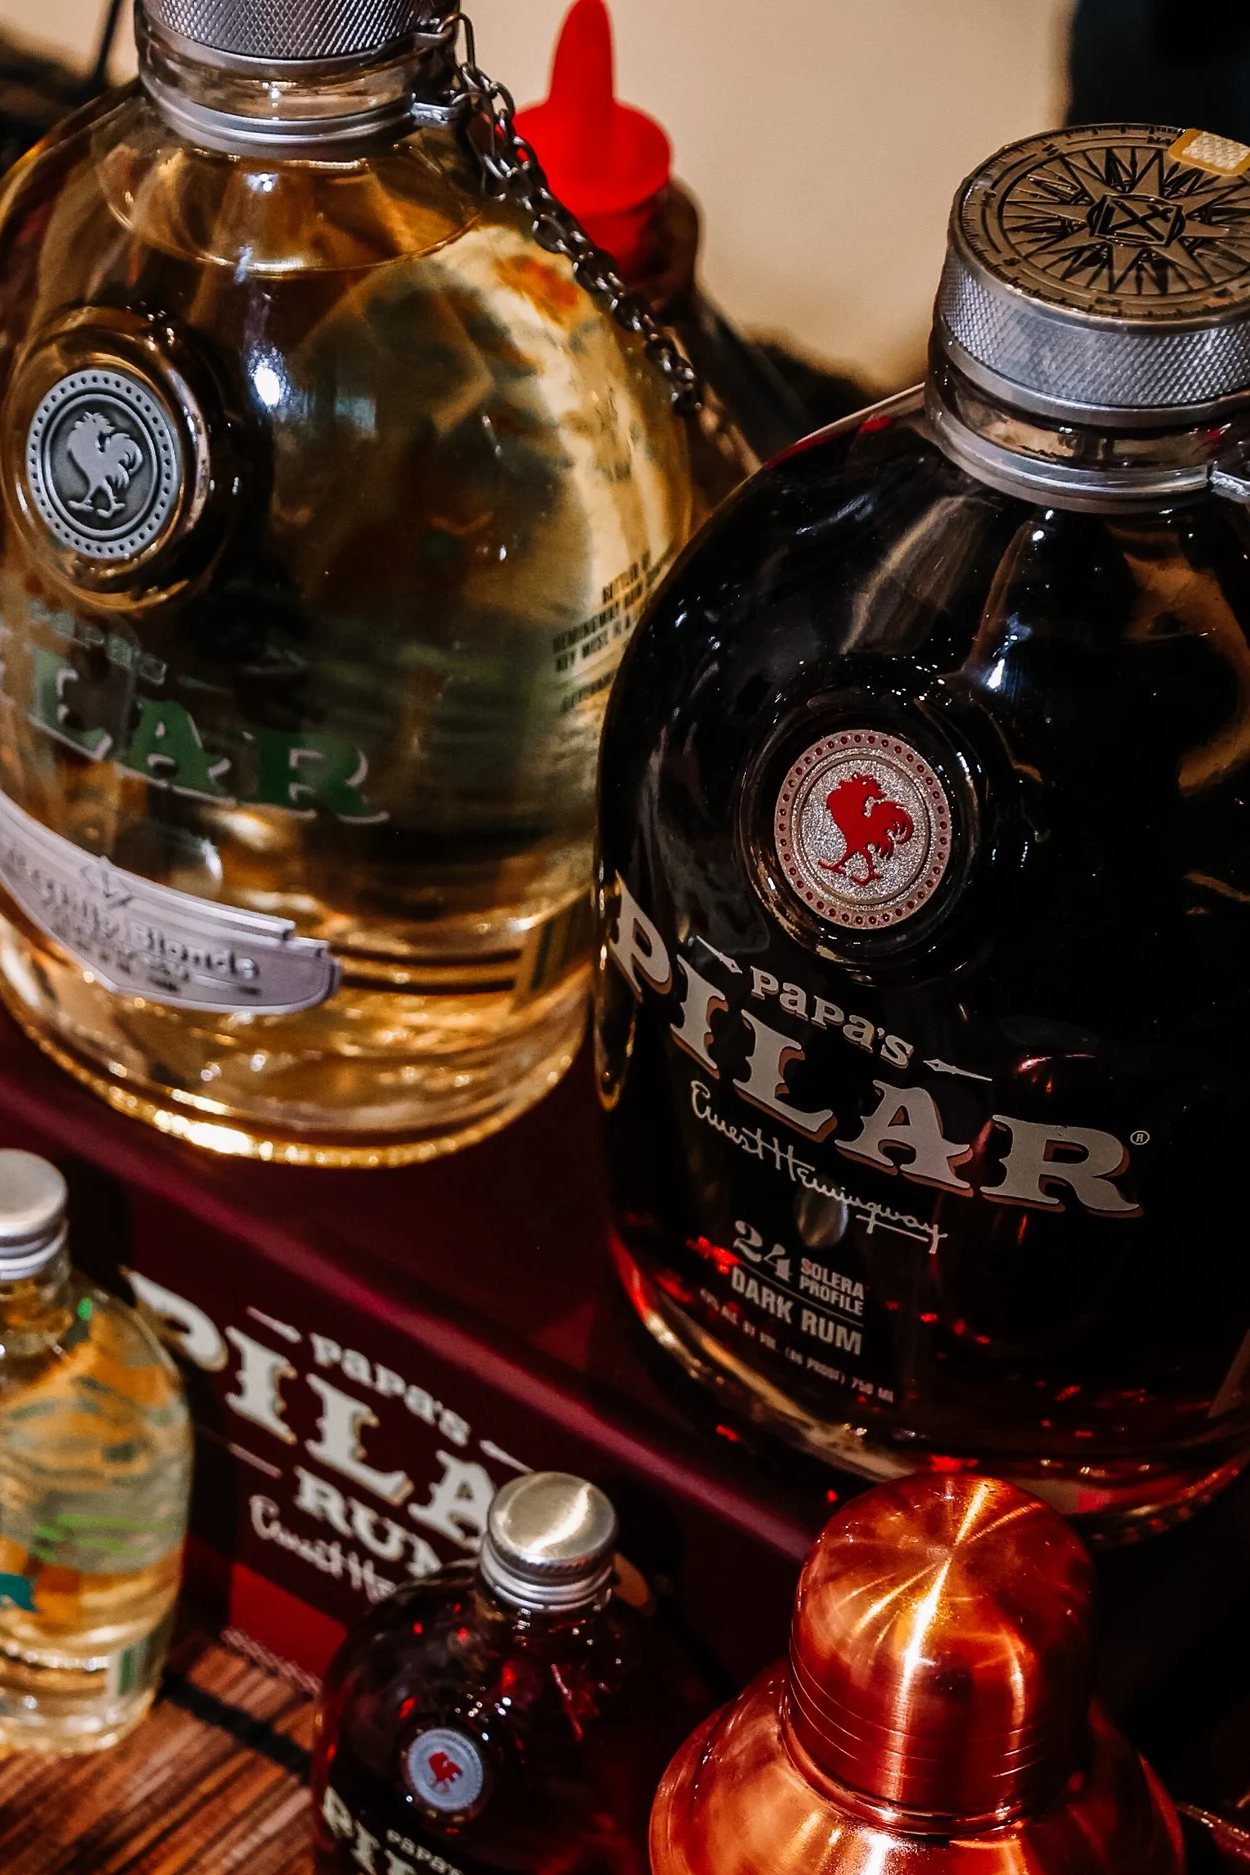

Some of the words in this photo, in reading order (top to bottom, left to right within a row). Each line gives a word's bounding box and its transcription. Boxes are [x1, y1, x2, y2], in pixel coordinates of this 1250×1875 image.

[607, 869, 1141, 1219] PILAR
[733, 1220, 793, 1283] 24
[801, 1257, 865, 1299] SOLERA
[799, 1275, 864, 1316] PROFILE
[731, 1266, 795, 1324] DARK
[801, 1308, 863, 1355] RUM
[119, 1265, 499, 1551] PILA
